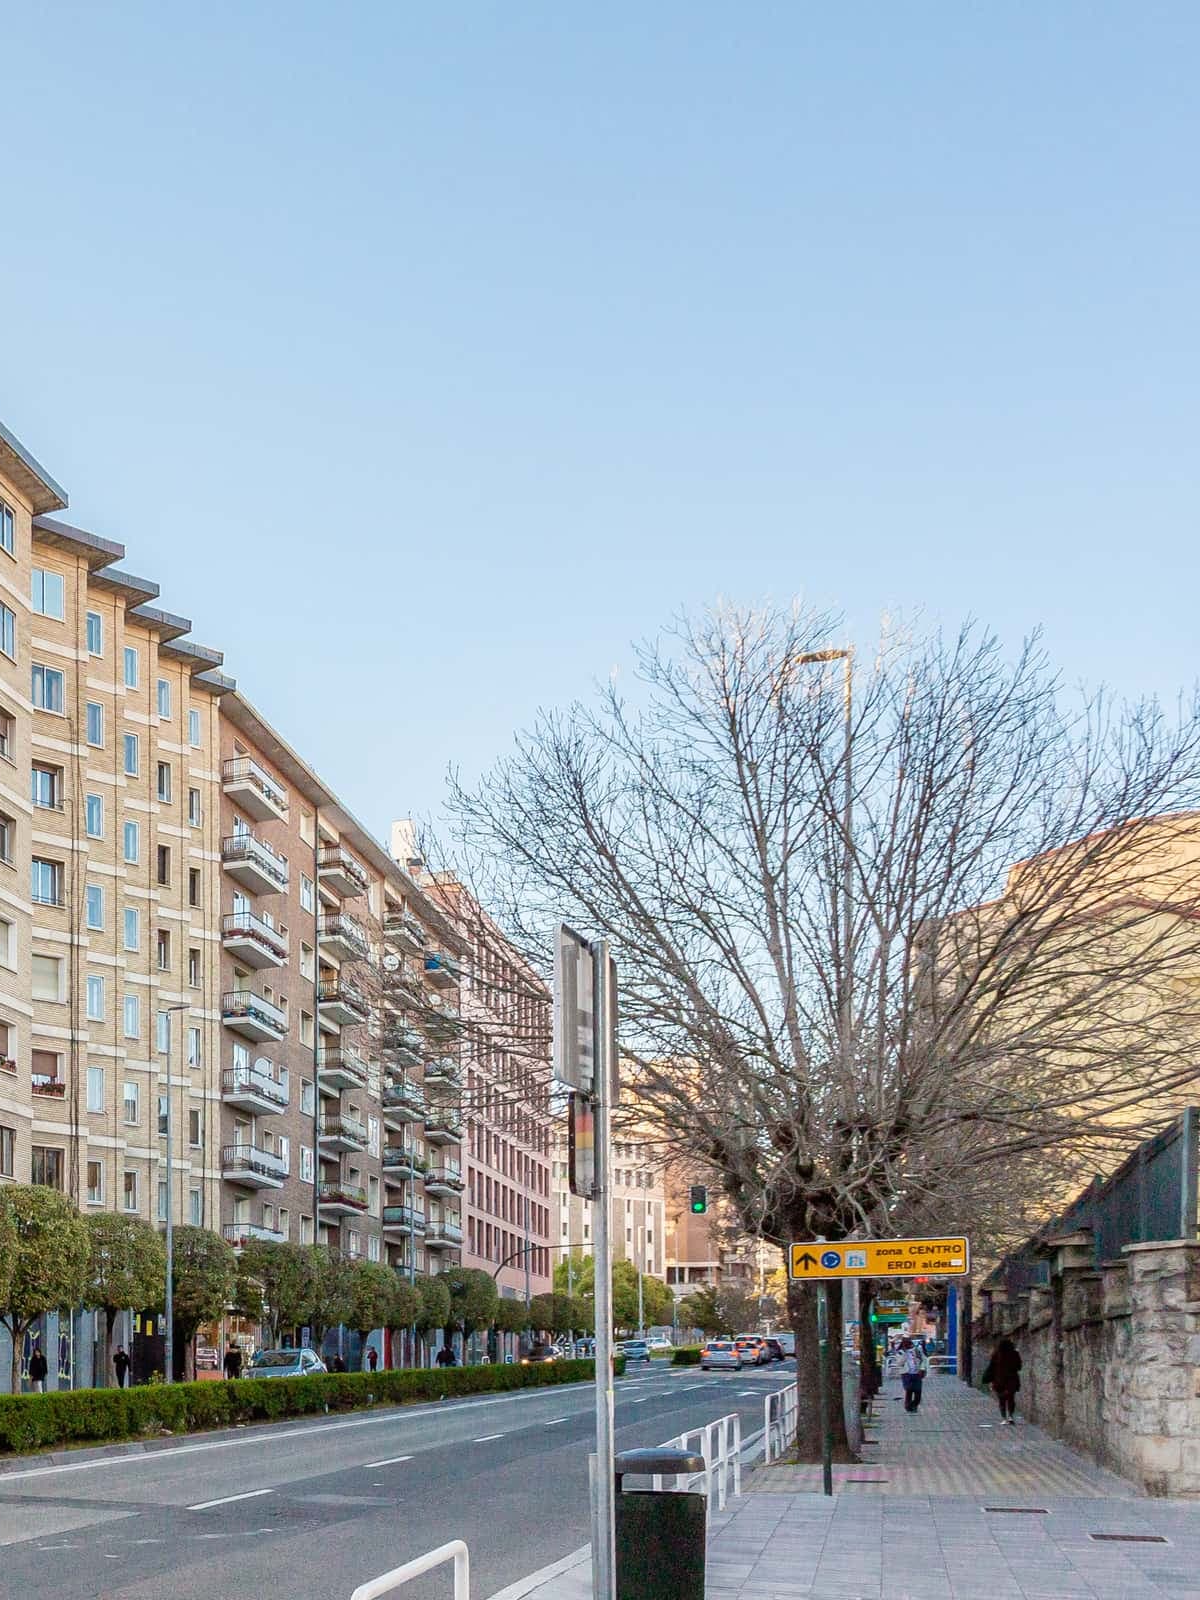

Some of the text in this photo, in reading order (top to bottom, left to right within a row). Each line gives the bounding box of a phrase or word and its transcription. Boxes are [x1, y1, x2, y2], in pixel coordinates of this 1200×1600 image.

[876, 1244, 962, 1256] zona CENTRO
[887, 1260, 916, 1270] ERDI
